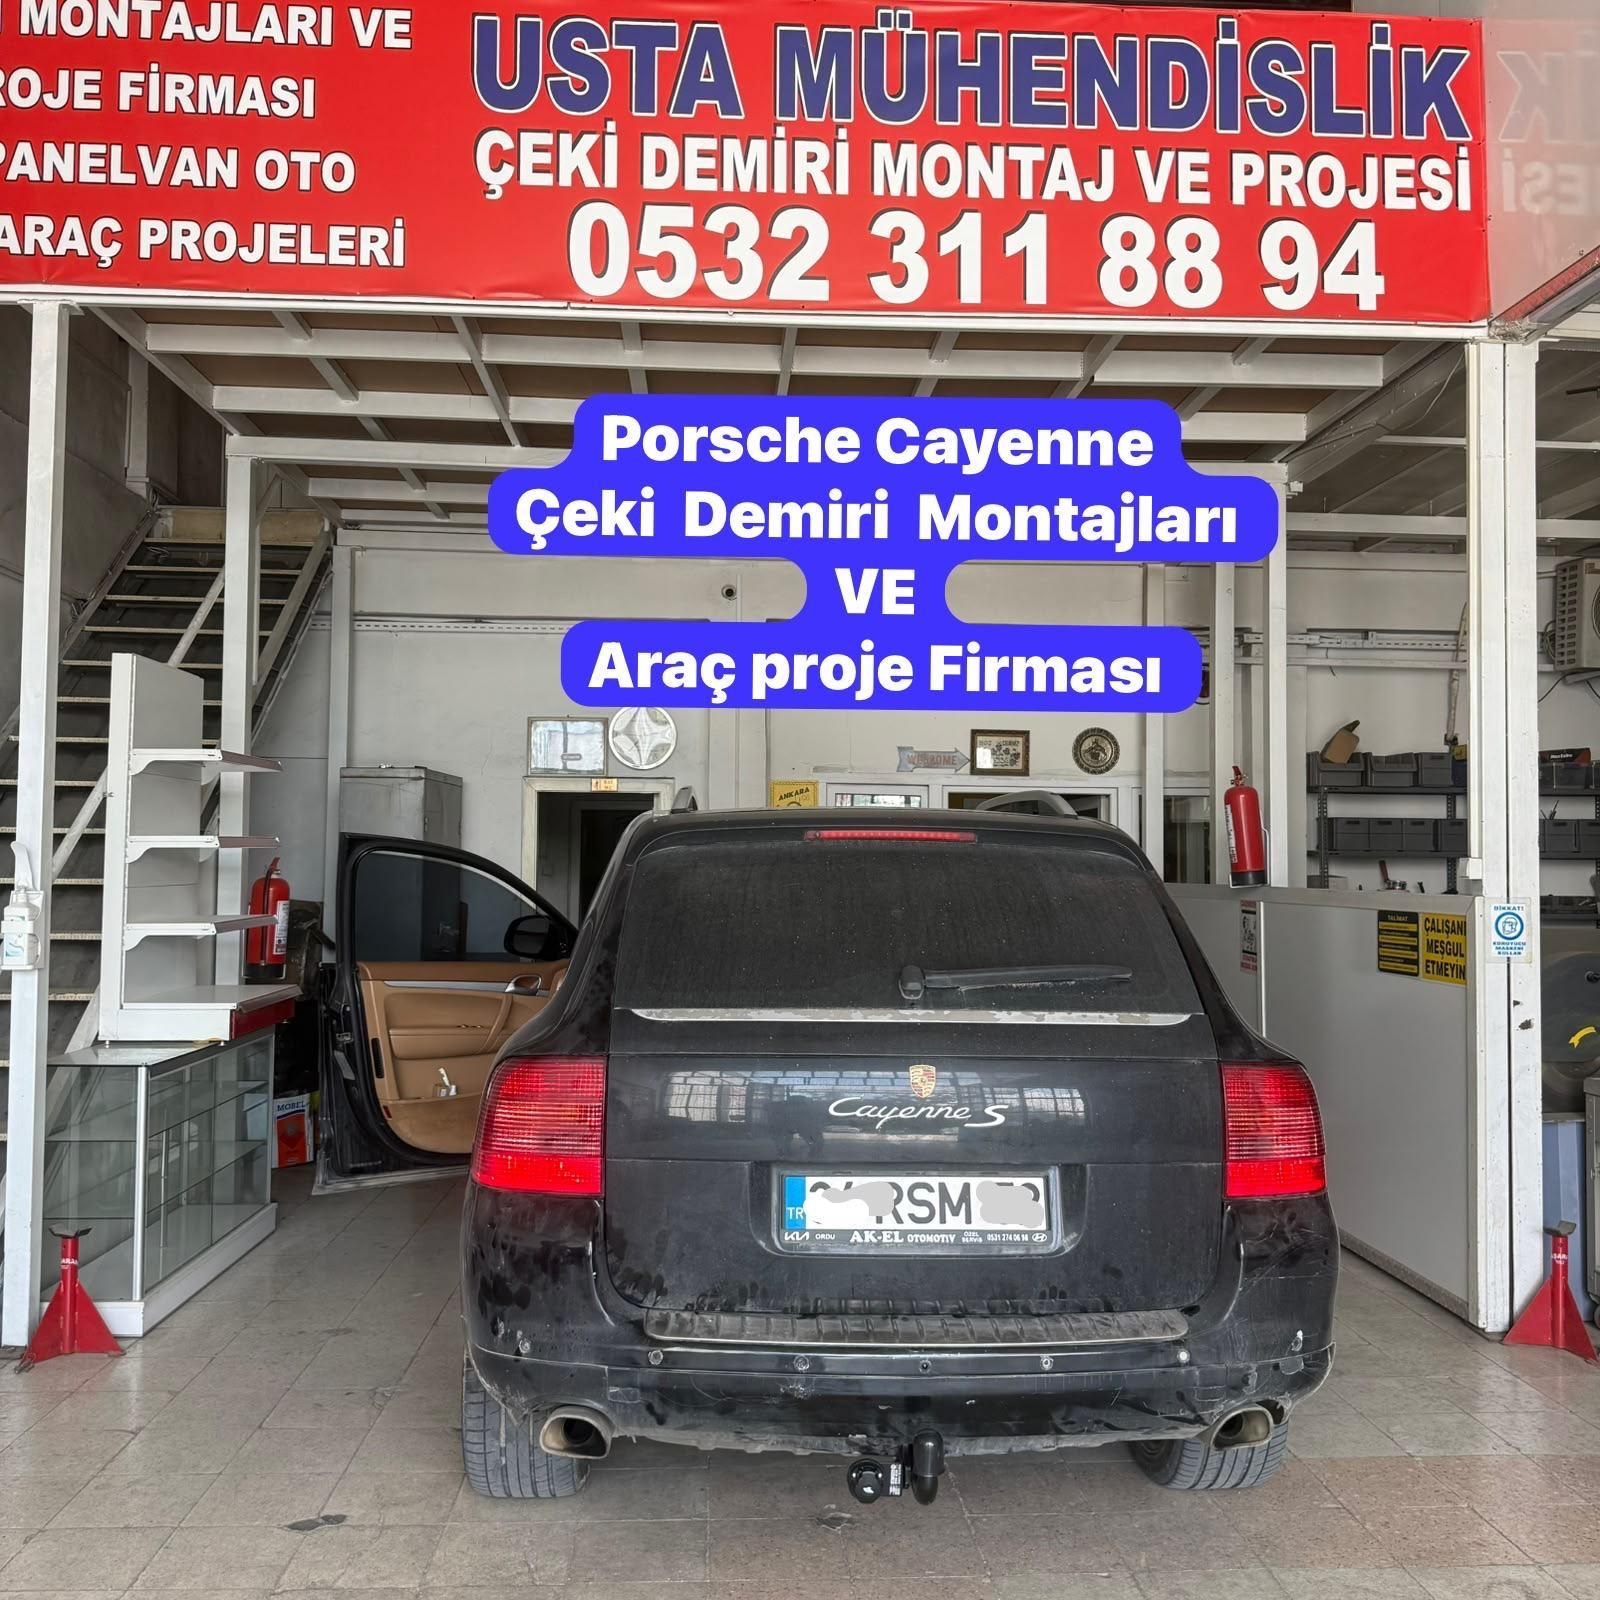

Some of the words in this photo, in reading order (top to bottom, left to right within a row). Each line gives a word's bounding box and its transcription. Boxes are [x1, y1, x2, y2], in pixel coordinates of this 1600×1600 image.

[21, 0, 332, 46] MONTAJLARI
[350, 8, 412, 49] VE
[0, 68, 101, 109] OJE
[119, 61, 314, 118] FİRMASI
[474, 15, 746, 120] USTA
[774, 8, 1473, 142] MÜHENDİSLİK
[0, 141, 238, 188] ANELVAN
[255, 150, 355, 192] OTO
[476, 120, 617, 199] ÇEKİ
[642, 127, 850, 195] DEMİRİ
[873, 142, 1115, 202] MONTAJ
[1135, 150, 1211, 205] VE
[1232, 146, 1471, 211] PROJESİ
[0, 214, 122, 268] ARAÇ
[139, 217, 404, 267] PROJELERİ
[569, 201, 830, 302] 0532
[869, 210, 1047, 305] 311
[1099, 215, 1223, 309] 88
[1260, 220, 1385, 311] 94
[778, 786, 810, 801] ANKARA
[1425, 958, 1467, 980] ETMEYİN
[1426, 938, 1465, 960] MEŞGUL
[828, 1094, 973, 1130] Cayenne
[964, 1104, 1009, 1128] S
[786, 1206, 804, 1221] TR
[850, 1230, 904, 1243] AK-EL
